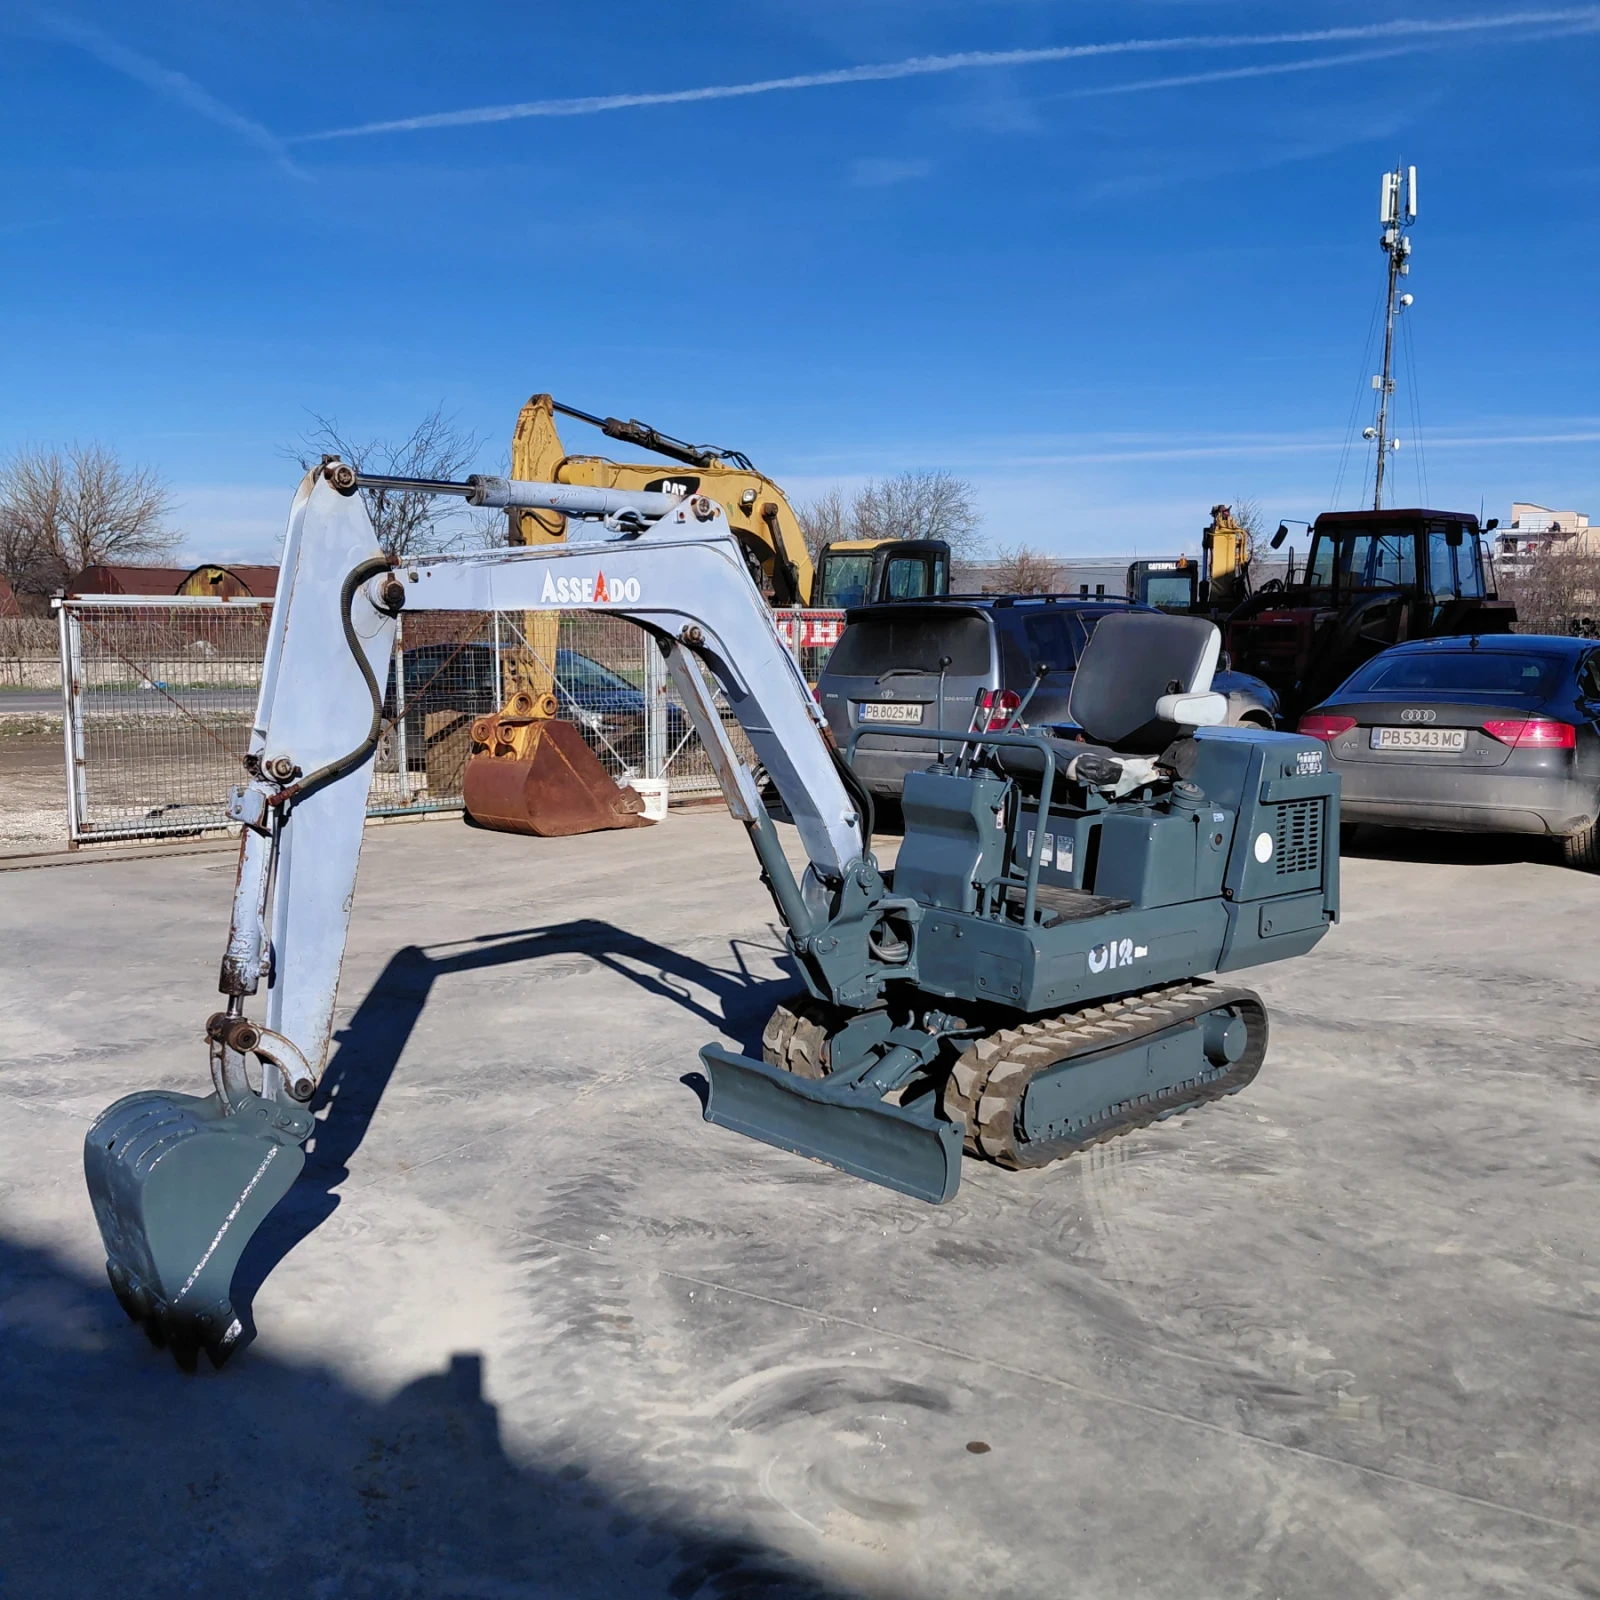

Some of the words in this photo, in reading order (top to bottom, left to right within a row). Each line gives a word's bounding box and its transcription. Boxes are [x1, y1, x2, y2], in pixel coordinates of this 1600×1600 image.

[662, 480, 687, 495] CAT
[1148, 562, 1177, 570] CATERPILL
[906, 706, 919, 720] MA
[1442, 732, 1462, 747] MC
